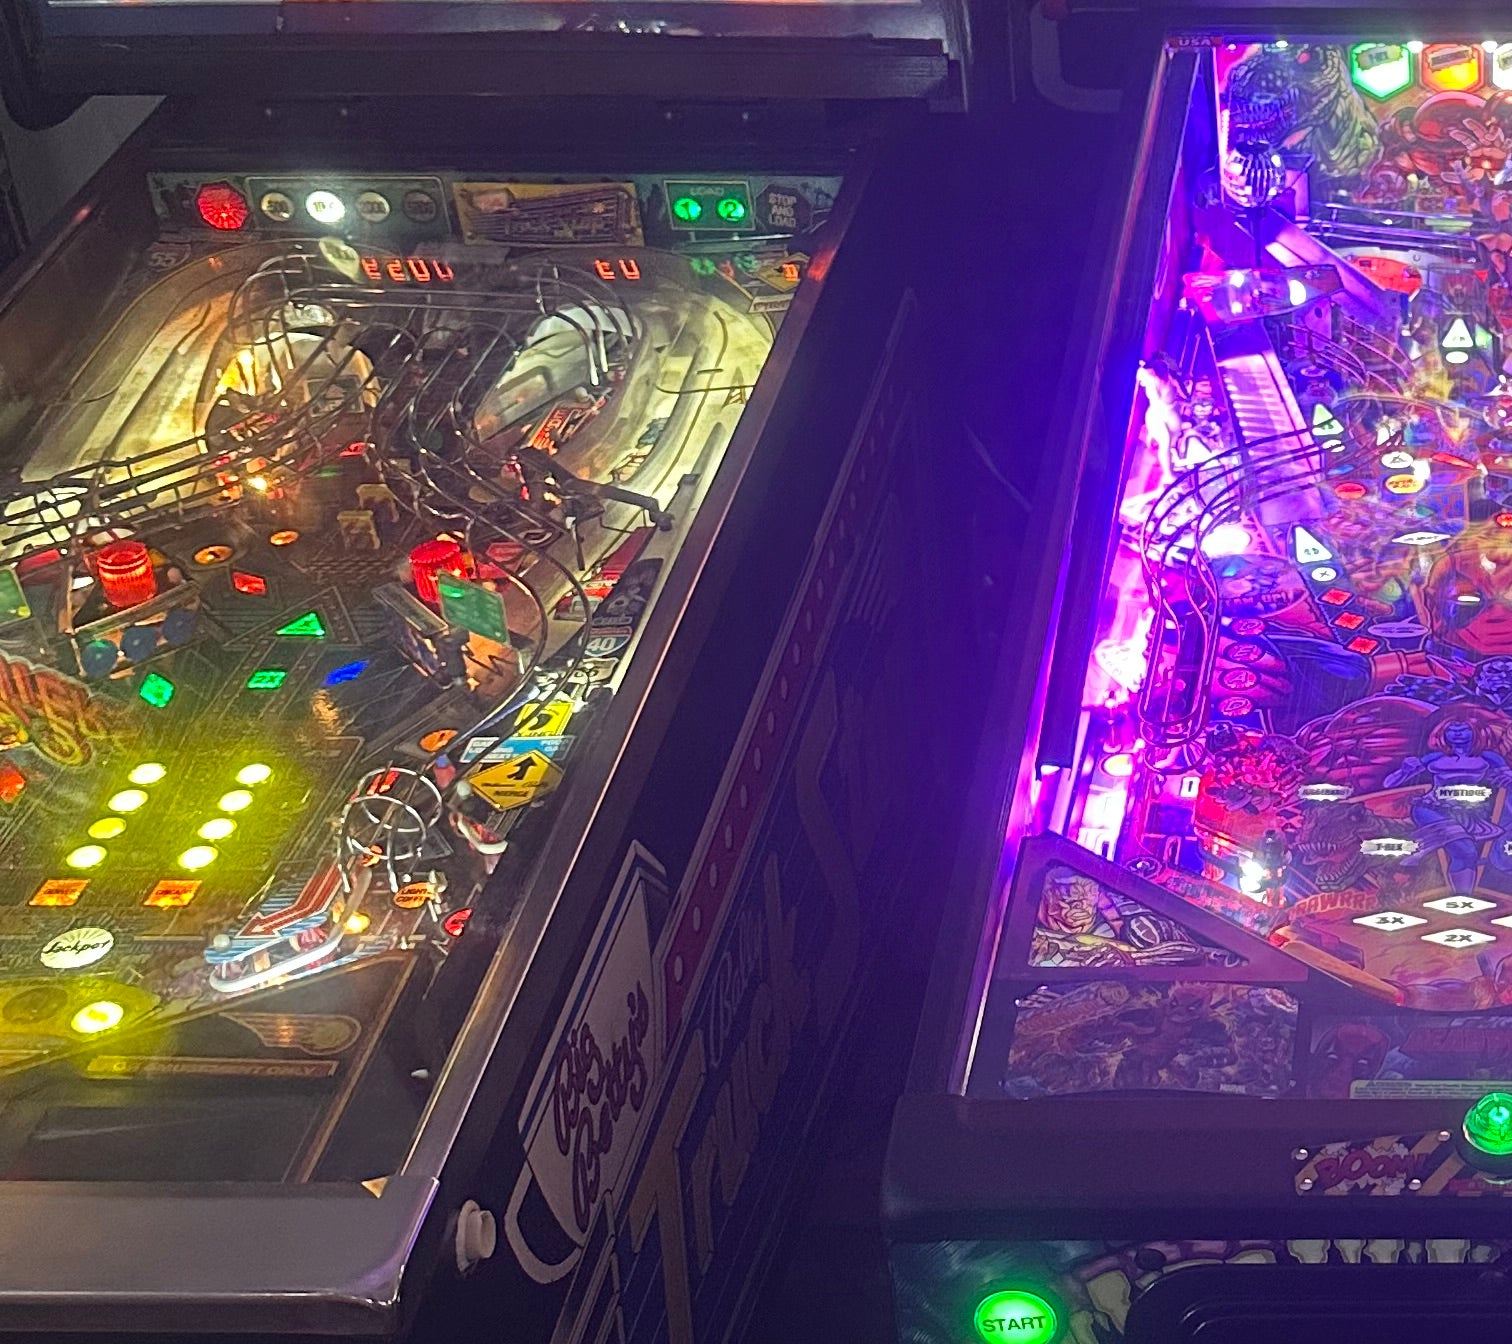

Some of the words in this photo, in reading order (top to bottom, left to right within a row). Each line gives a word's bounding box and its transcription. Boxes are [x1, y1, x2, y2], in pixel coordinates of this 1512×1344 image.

[768, 194, 797, 206] STOP
[722, 201, 741, 219] 2
[768, 215, 796, 228] LOAD
[588, 636, 616, 652] 40
[1445, 901, 1473, 910] 5X
[1374, 916, 1404, 926] 3X
[1444, 933, 1472, 943] 2X
[553, 1021, 602, 1157] Big
[982, 1315, 1047, 1334] START
